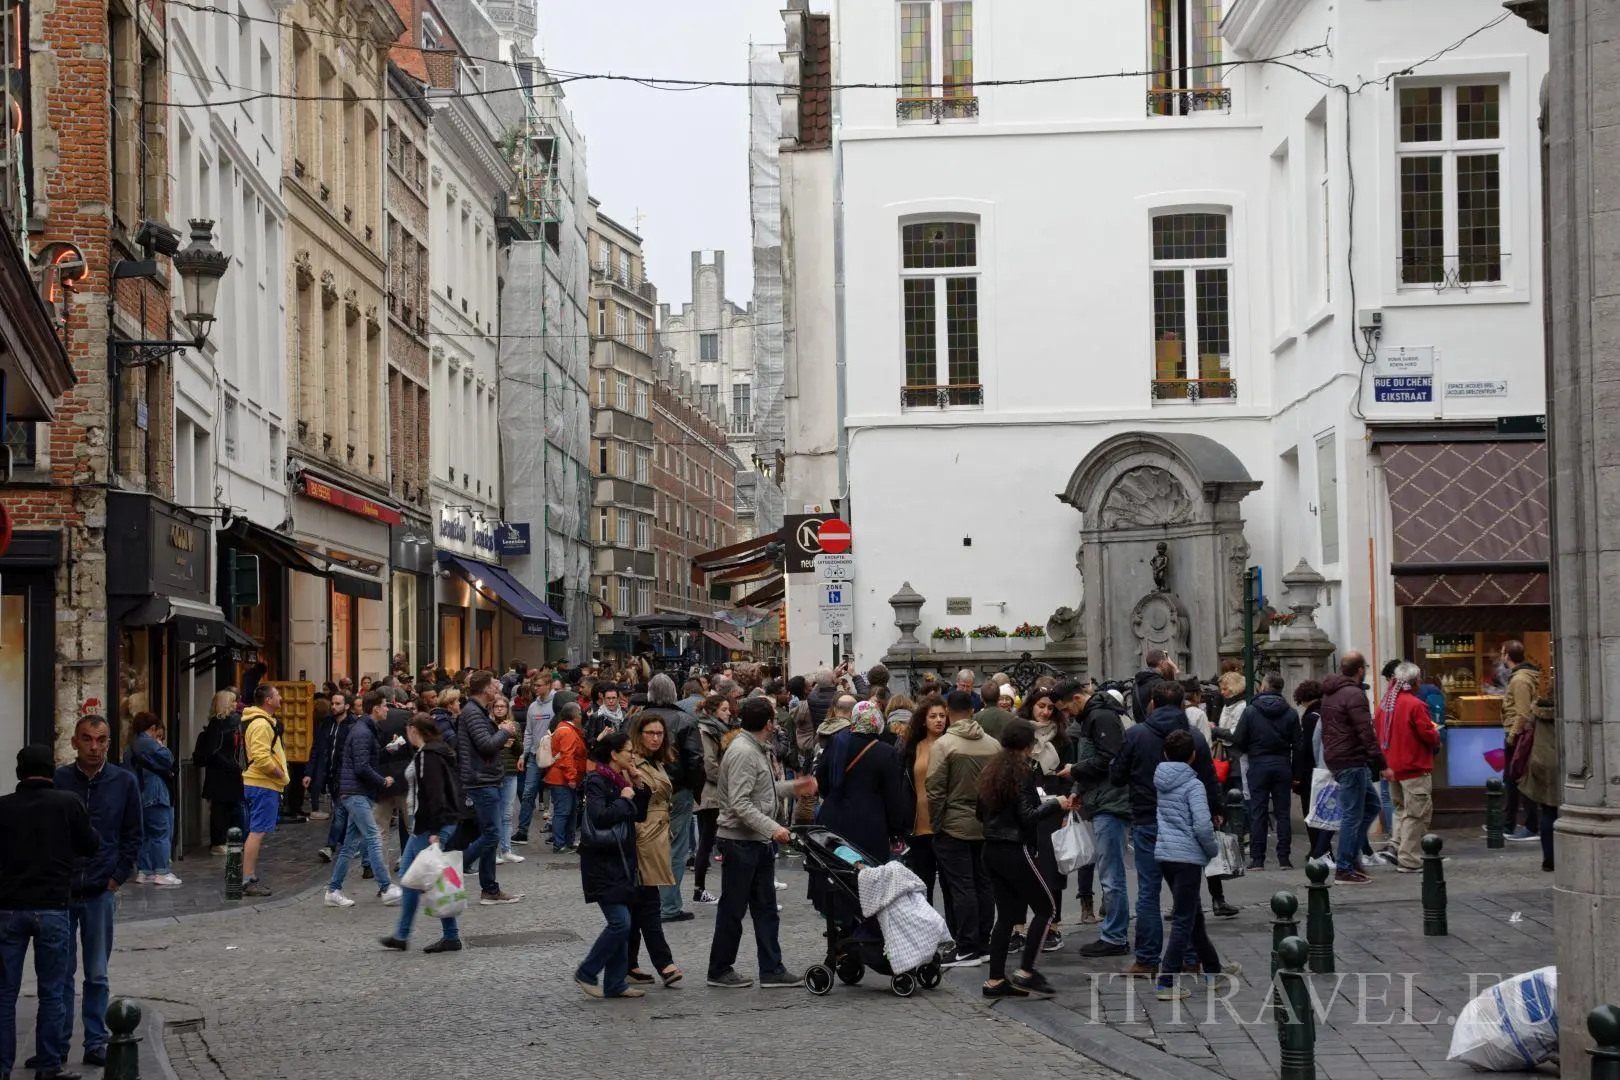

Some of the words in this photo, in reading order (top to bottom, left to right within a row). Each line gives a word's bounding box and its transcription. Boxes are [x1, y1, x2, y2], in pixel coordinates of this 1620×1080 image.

[1375, 379, 1391, 387] RUE
[1393, 378, 1404, 387] DU
[1406, 376, 1432, 387] CHÊNE
[1381, 392, 1427, 401] EIKSTRAAT
